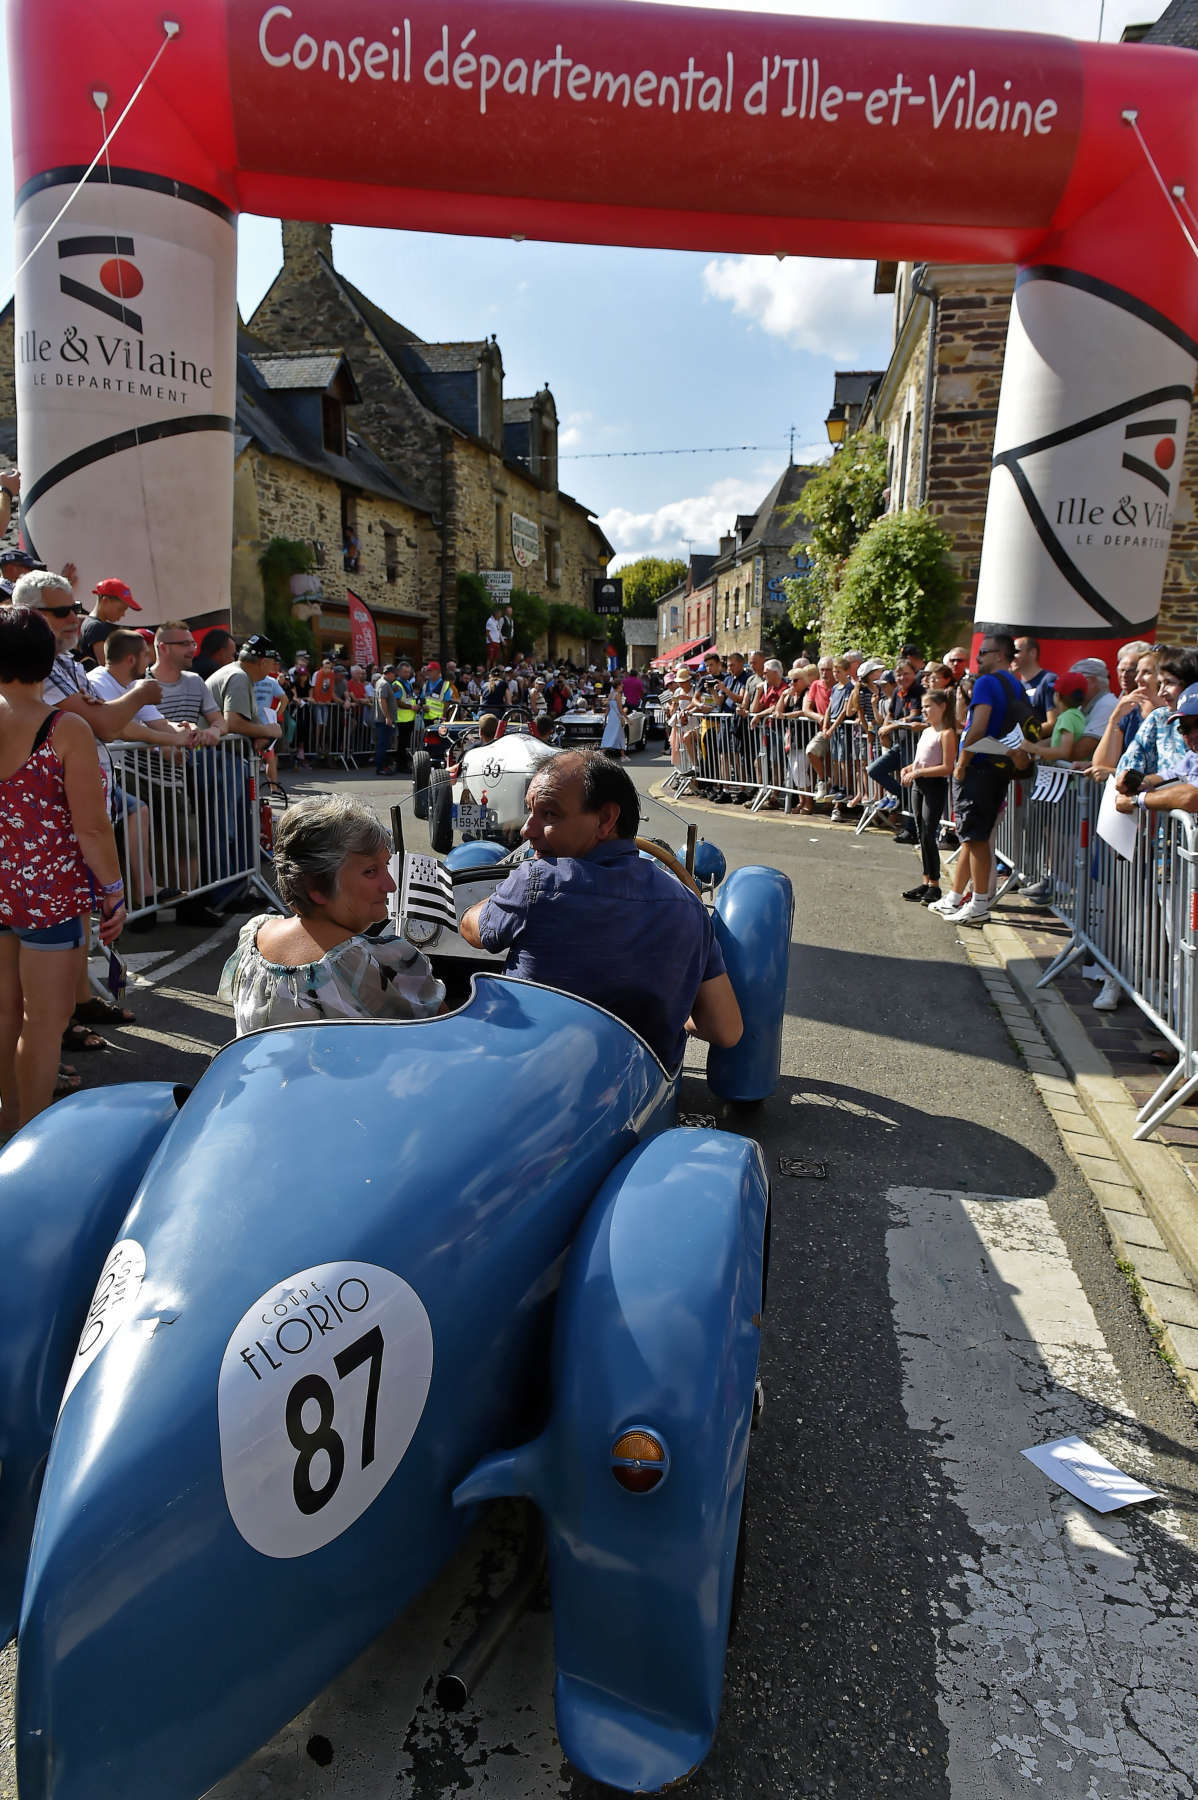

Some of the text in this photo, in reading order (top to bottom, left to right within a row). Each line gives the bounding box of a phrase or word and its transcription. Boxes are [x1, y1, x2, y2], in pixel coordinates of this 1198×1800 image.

[259, 6, 1058, 136] Conseil départemental d'Ille-et-Vilaine
[60, 326, 90, 366] &
[95, 335, 213, 388] Vilaine
[33, 373, 188, 404] LE DEPARTEMENT
[1056, 498, 1104, 525] Ille
[1112, 495, 1137, 527] &
[1076, 534, 1094, 545] LE
[240, 1278, 370, 1380] FLORIO
[285, 1325, 385, 1515] 87
